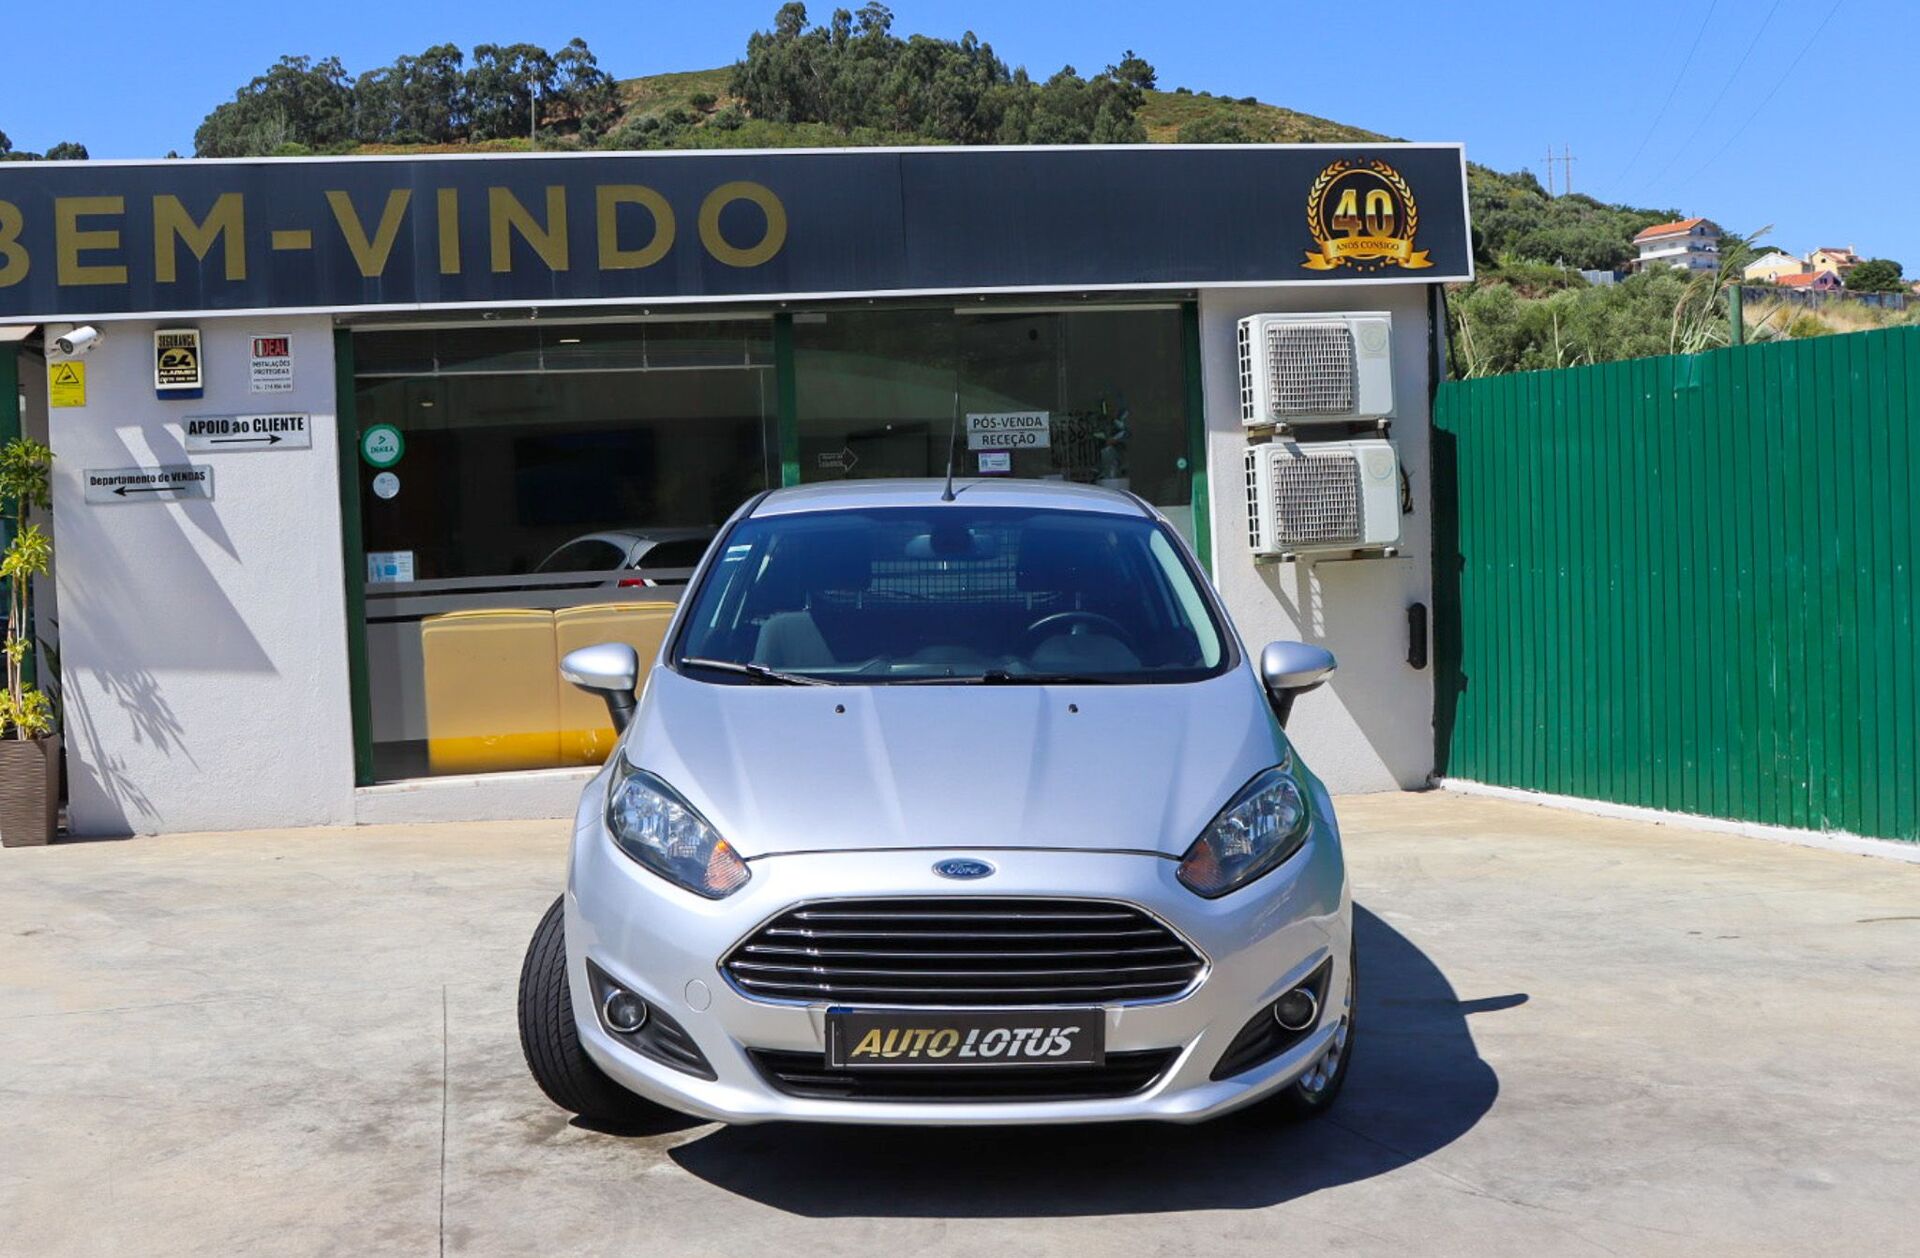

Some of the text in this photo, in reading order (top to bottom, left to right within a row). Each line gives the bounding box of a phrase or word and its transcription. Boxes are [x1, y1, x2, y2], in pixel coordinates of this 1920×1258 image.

[1331, 188, 1395, 238] 40
[1336, 241, 1400, 251] ANOS CONSIGO
[189, 417, 304, 435] APOIO ao CLIENTE
[973, 416, 1042, 429] PÓS-VENDA
[982, 431, 1036, 447] RECEÇÃO
[90, 471, 206, 487] Departamento de VENDAS
